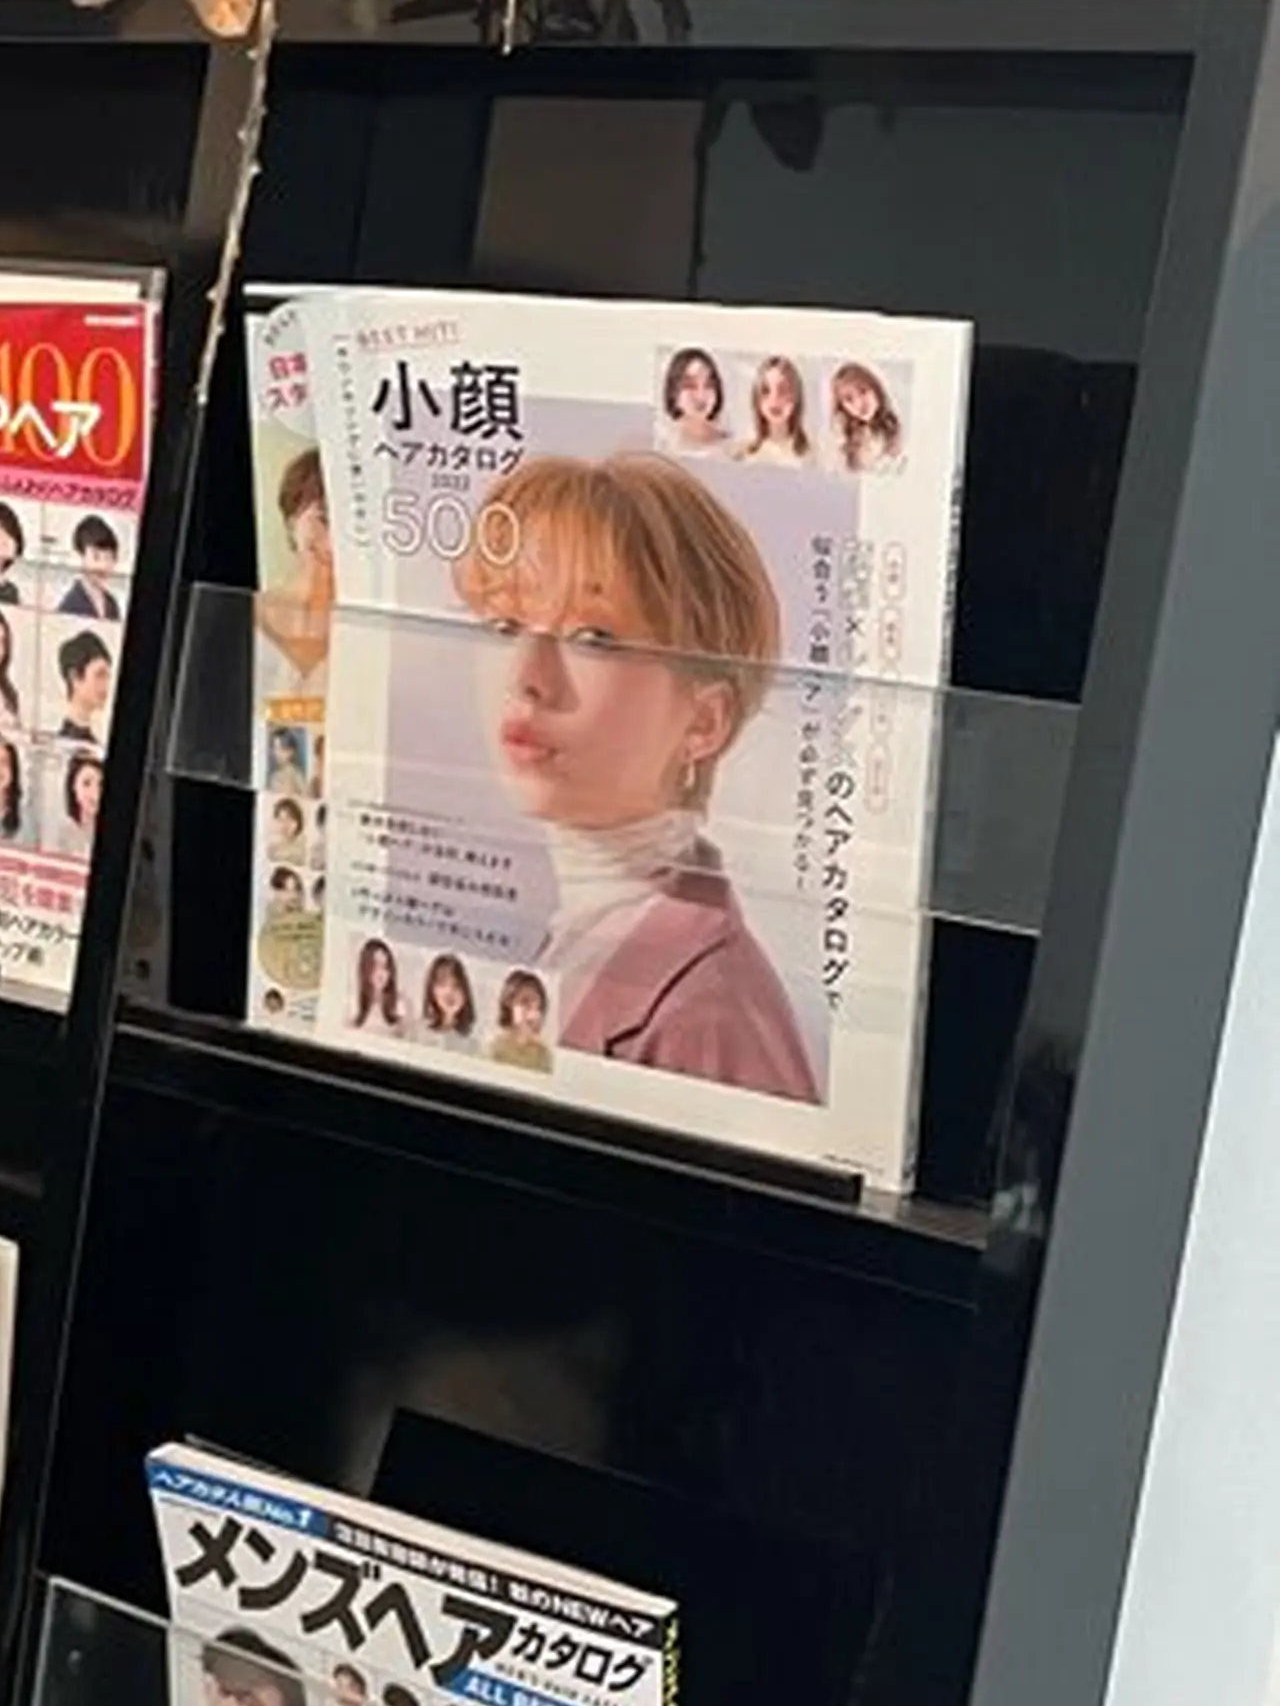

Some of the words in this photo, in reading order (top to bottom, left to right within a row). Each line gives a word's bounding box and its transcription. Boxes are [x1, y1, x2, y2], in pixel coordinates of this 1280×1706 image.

[370, 360, 525, 441] 小顔
[372, 441, 525, 476] ヘアカタログ
[381, 486, 521, 566] 500
[174, 1517, 518, 1689] メンズヘア
[511, 1620, 650, 1694] カタログ
